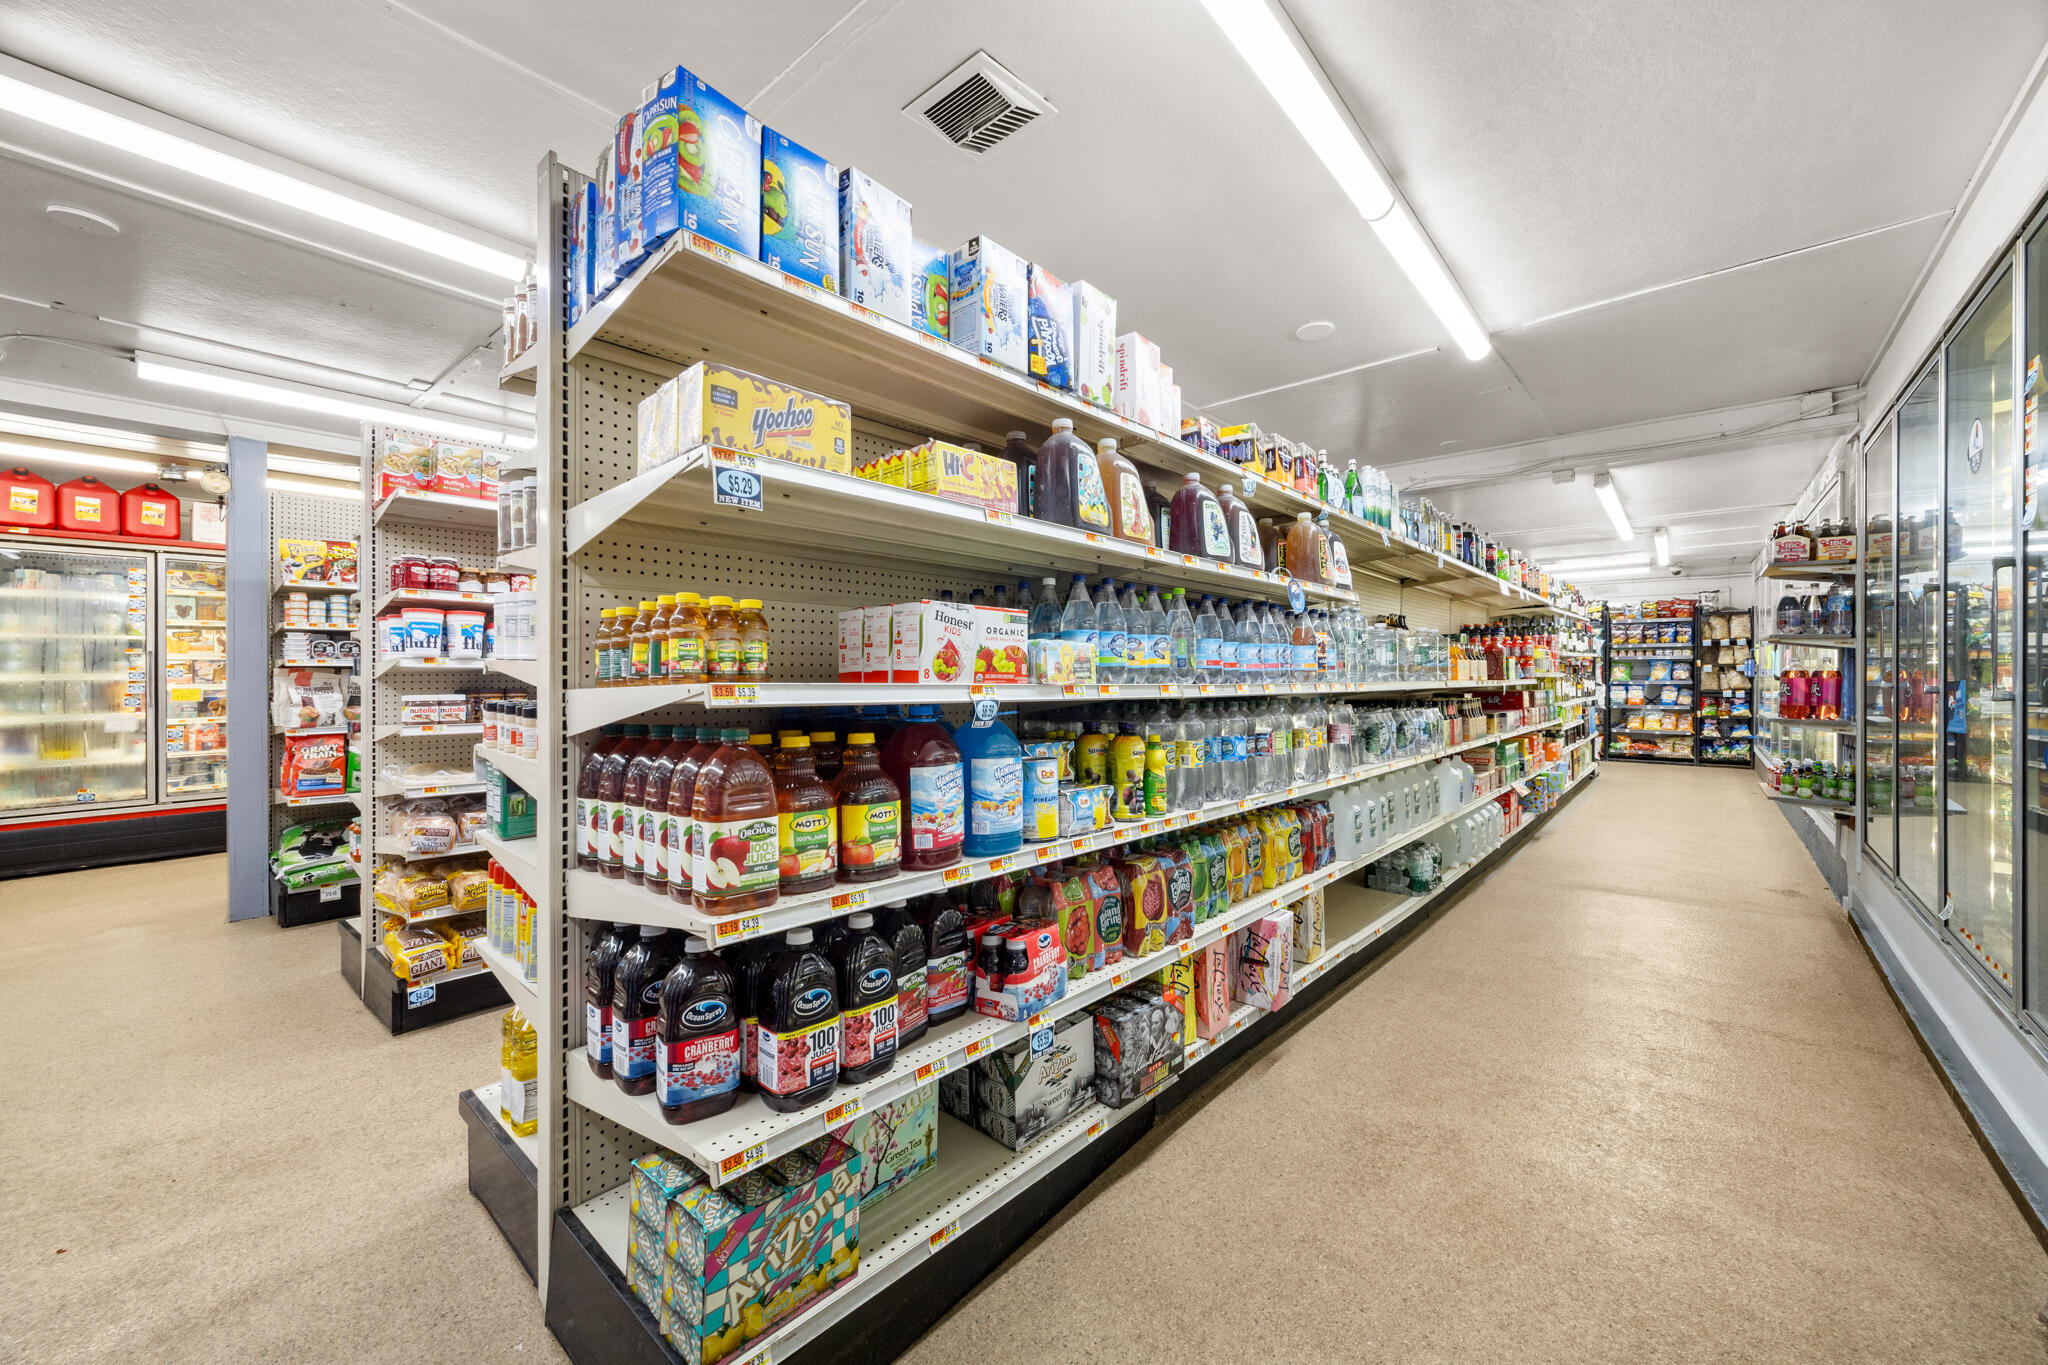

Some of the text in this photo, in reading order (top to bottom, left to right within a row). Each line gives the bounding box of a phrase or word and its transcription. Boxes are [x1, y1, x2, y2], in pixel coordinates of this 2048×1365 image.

[687, 212, 698, 230] 10
[857, 290, 865, 304] 10
[986, 341, 993, 353] 10
[1116, 342, 1129, 391] spindrift
[728, 478, 753, 497] $5.29
[718, 493, 762, 510] NEW ITEM
[934, 609, 974, 631] Honest
[985, 626, 1025, 637] ORGANIC
[866, 651, 871, 663] 8
[896, 648, 901, 660] 8
[923, 668, 930, 679] 8
[714, 687, 756, 697] $3.59 $5.39
[409, 706, 437, 714] nutella
[300, 743, 339, 754] GRAVY
[302, 750, 339, 760] TRAIN
[1040, 768, 1055, 779] Dole
[869, 809, 897, 820] MOTT'S
[794, 817, 828, 829] MOTT'S
[740, 826, 777, 839] ORCHARD
[750, 841, 777, 854] 100%
[744, 851, 777, 865] JUICE
[850, 894, 866, 905] $5.19
[719, 917, 760, 936] $2.19 $4.39
[938, 958, 962, 972] ORCHARD
[1032, 946, 1060, 971] CRANBERRY
[410, 957, 444, 976] GIANT
[862, 973, 889, 989] Ocean Spray
[903, 975, 925, 990] ORCHARD
[797, 994, 828, 1009] Ocean Spray
[686, 1007, 723, 1022] Ocean Spray
[874, 1022, 896, 1035] JUICE
[684, 1035, 735, 1058] CRANBERRY
[810, 1044, 837, 1060] JUICE
[1038, 1052, 1078, 1085] AriZona
[844, 1099, 859, 1113] $5.79
[1042, 1092, 1063, 1108] Sweet
[745, 1149, 764, 1163] $4.99
[885, 1147, 909, 1165] Green
[908, 1137, 924, 1152] Tea
[720, 1228, 737, 1250] PACK
[724, 1168, 854, 1329] AriZona
[715, 1250, 730, 1266] NO
